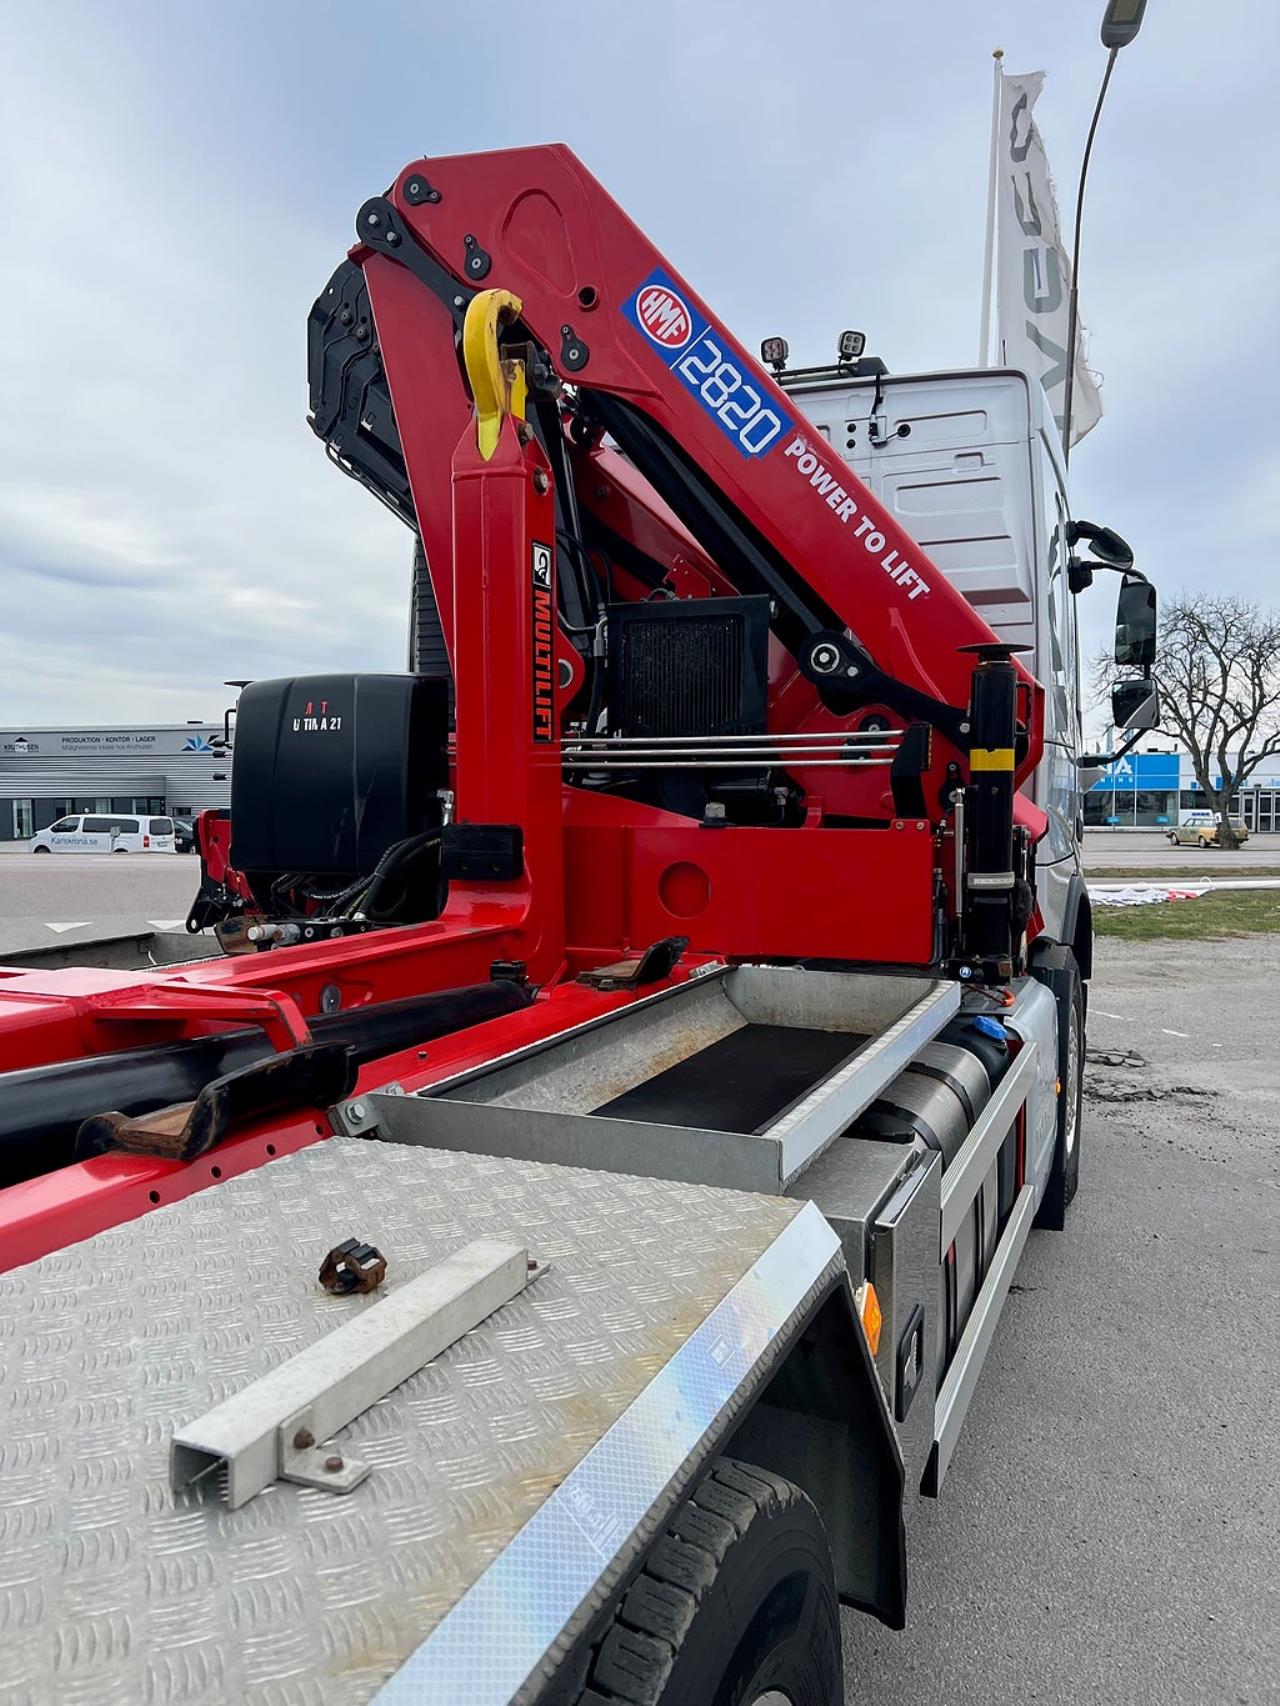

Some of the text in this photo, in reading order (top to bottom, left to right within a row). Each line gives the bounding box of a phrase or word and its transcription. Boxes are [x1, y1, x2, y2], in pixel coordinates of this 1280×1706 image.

[640, 290, 688, 340] HMF
[678, 338, 782, 456] 2820
[784, 438, 931, 601] POWER TO LIFT
[329, 717, 342, 731] 21
[534, 590, 552, 740] MULTILIFT
